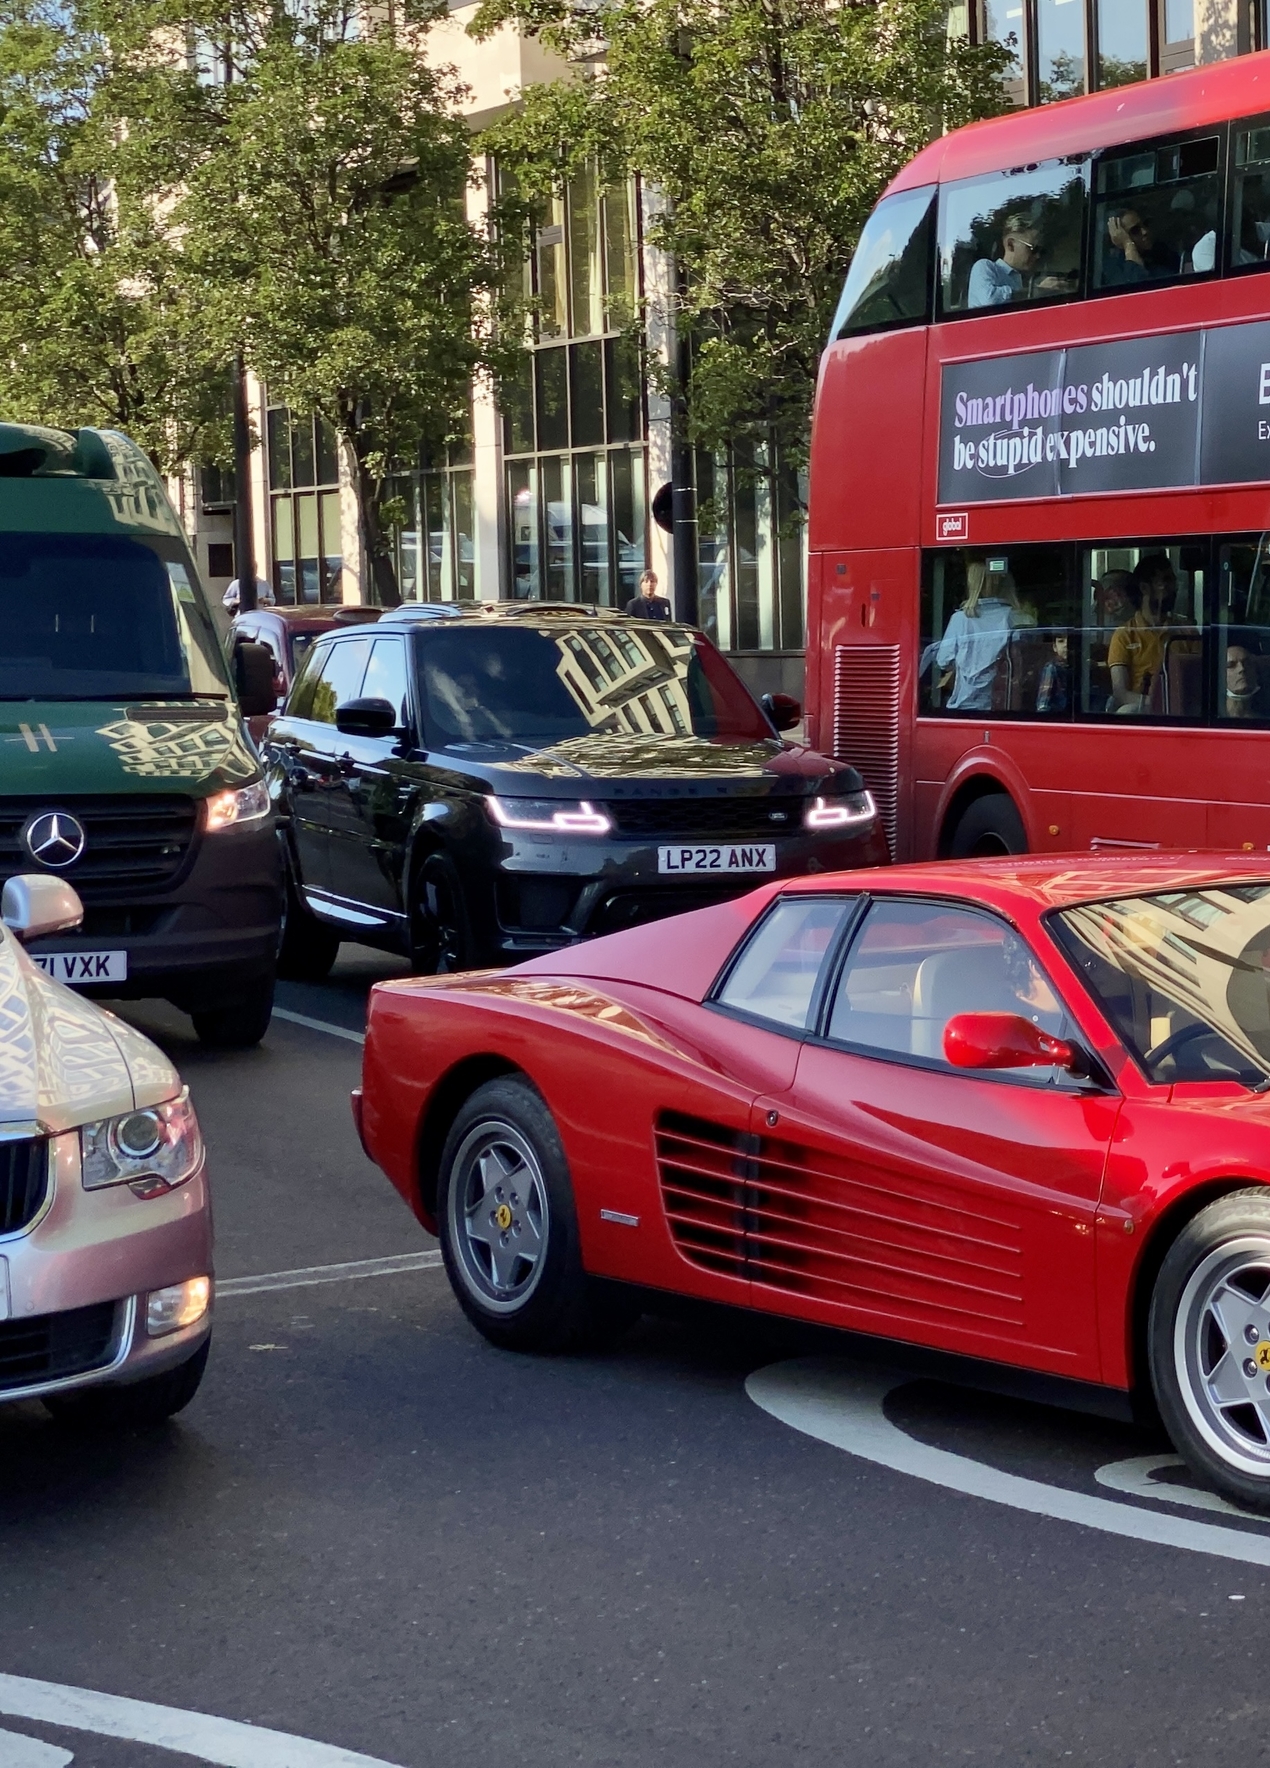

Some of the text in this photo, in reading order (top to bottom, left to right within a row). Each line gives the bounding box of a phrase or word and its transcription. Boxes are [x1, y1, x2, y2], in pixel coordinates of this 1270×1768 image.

[954, 362, 1198, 430] Smartphones shouldn't
[953, 415, 1156, 475] be stupid expensive.
[942, 517, 962, 537] global
[666, 847, 767, 870] LP22 ANX
[63, 955, 110, 978] VXK
